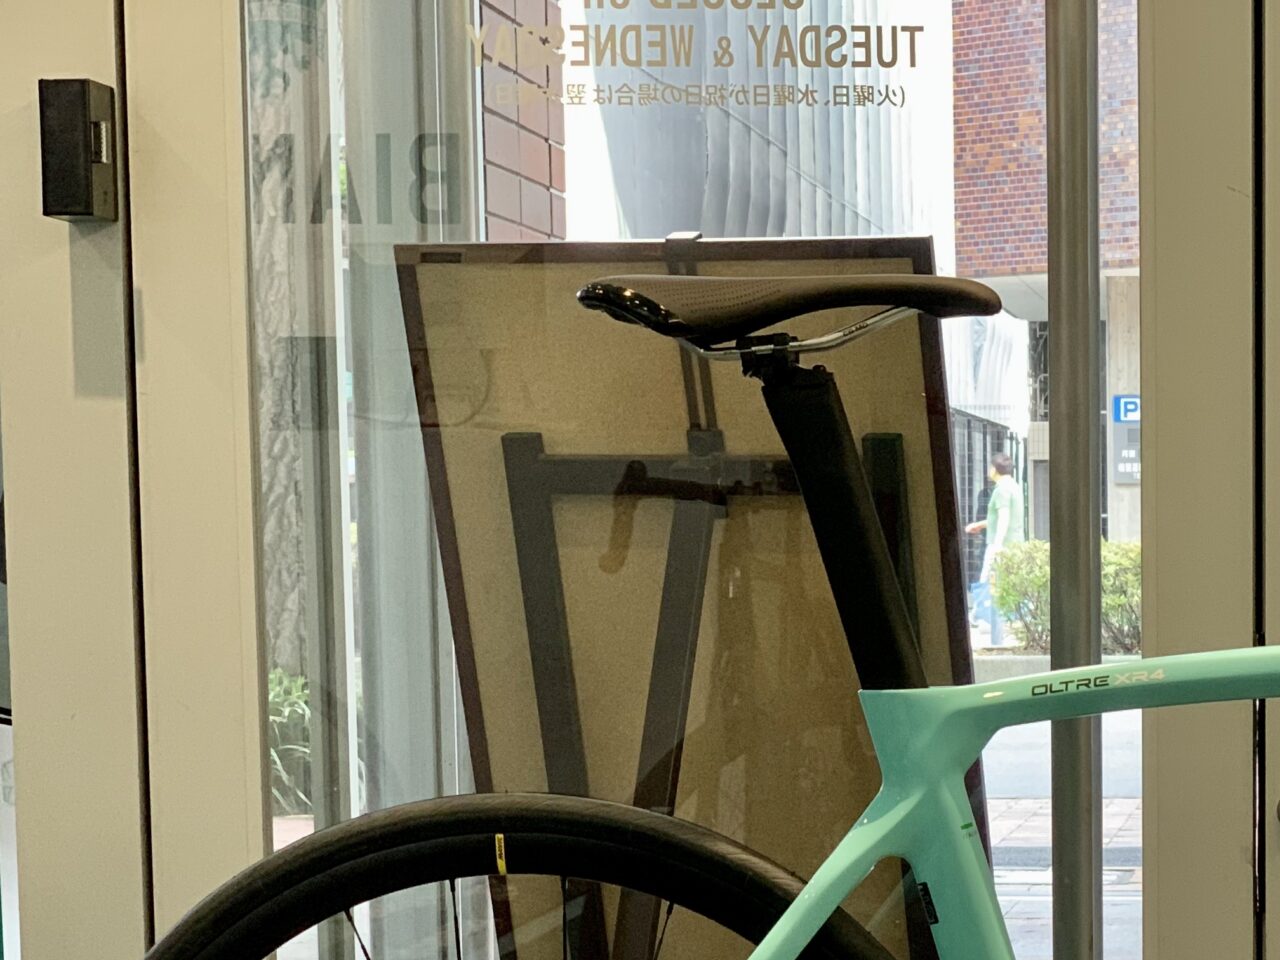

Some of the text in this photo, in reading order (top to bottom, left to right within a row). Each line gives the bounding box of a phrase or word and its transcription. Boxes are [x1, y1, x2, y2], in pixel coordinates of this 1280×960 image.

[1123, 401, 1139, 418] P
[1031, 668, 1166, 697] OLTRE XR4
